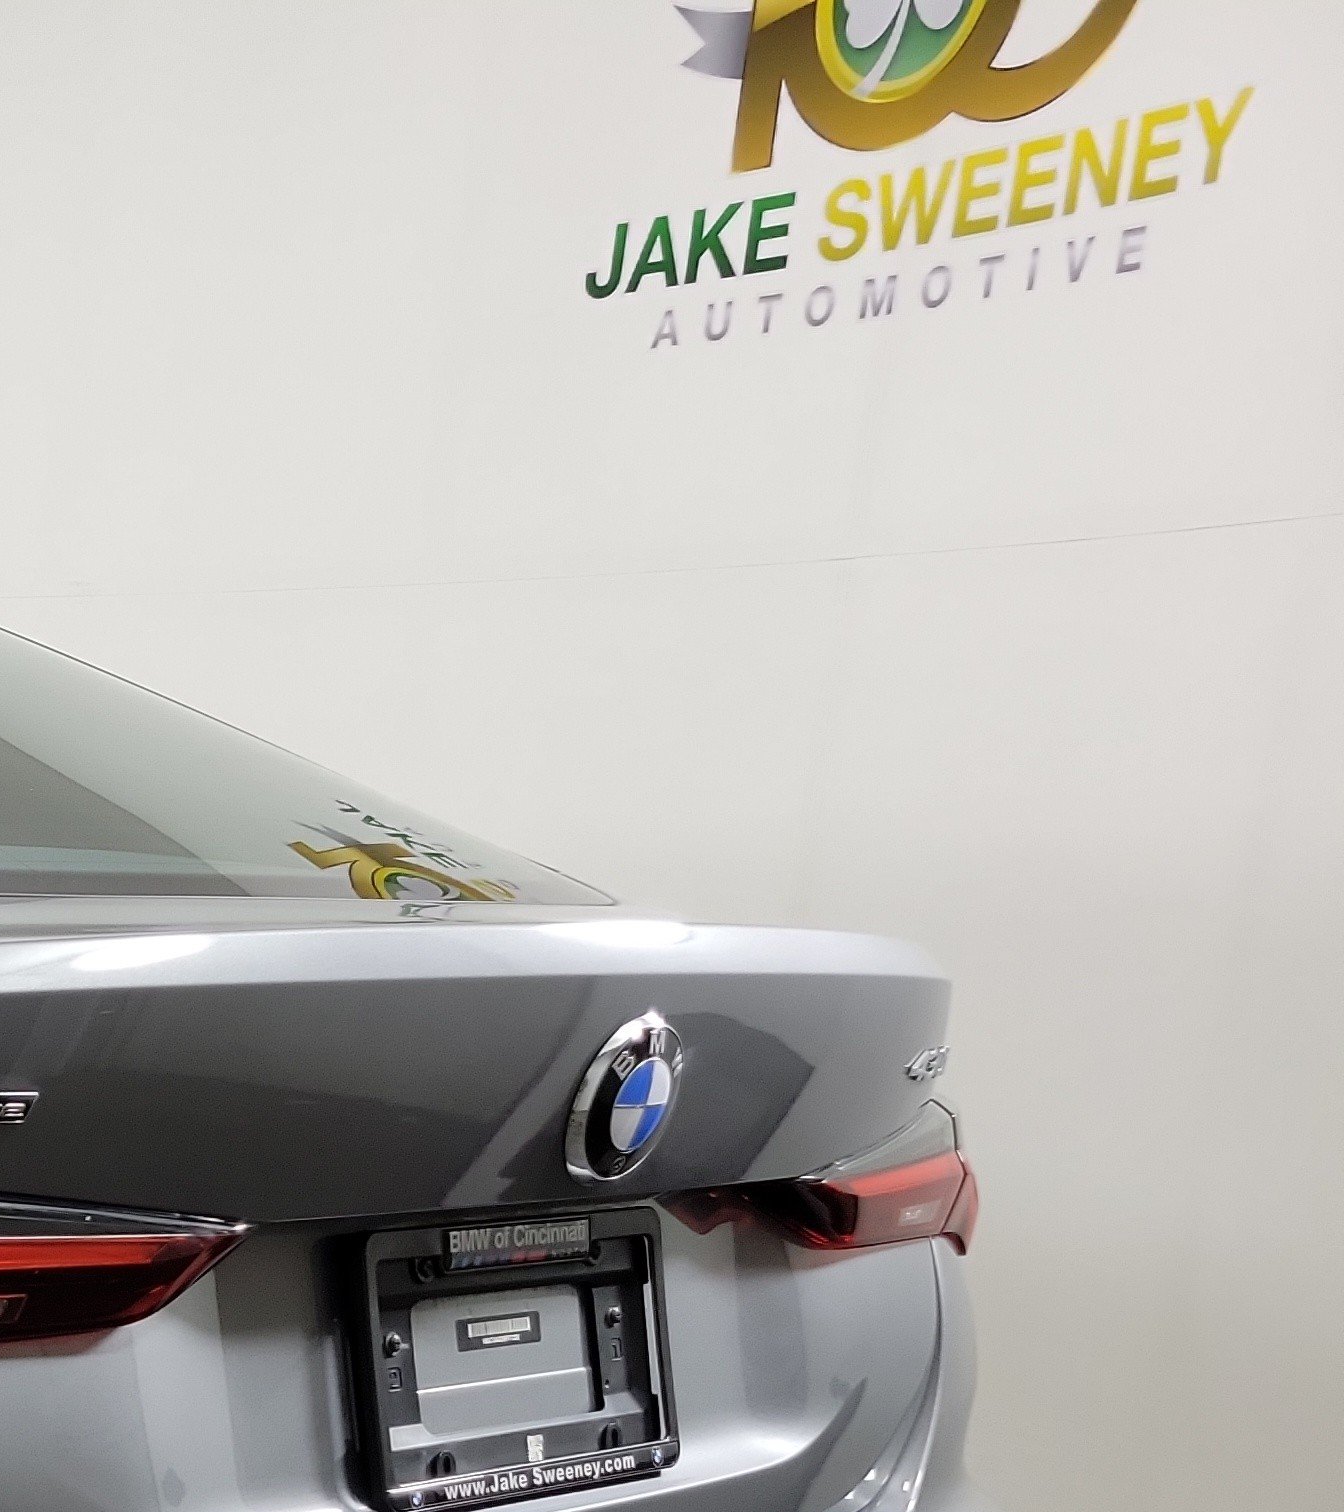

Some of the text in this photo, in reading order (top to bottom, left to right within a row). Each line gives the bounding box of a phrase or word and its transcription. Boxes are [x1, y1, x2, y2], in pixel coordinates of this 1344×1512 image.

[584, 87, 1255, 299] JAKE SWEENEY
[651, 227, 1149, 349] AUTOMOTIVE
[450, 1219, 586, 1253] BMW of Cincinnati
[444, 1455, 636, 1500] www.Jake Sweeney.com
